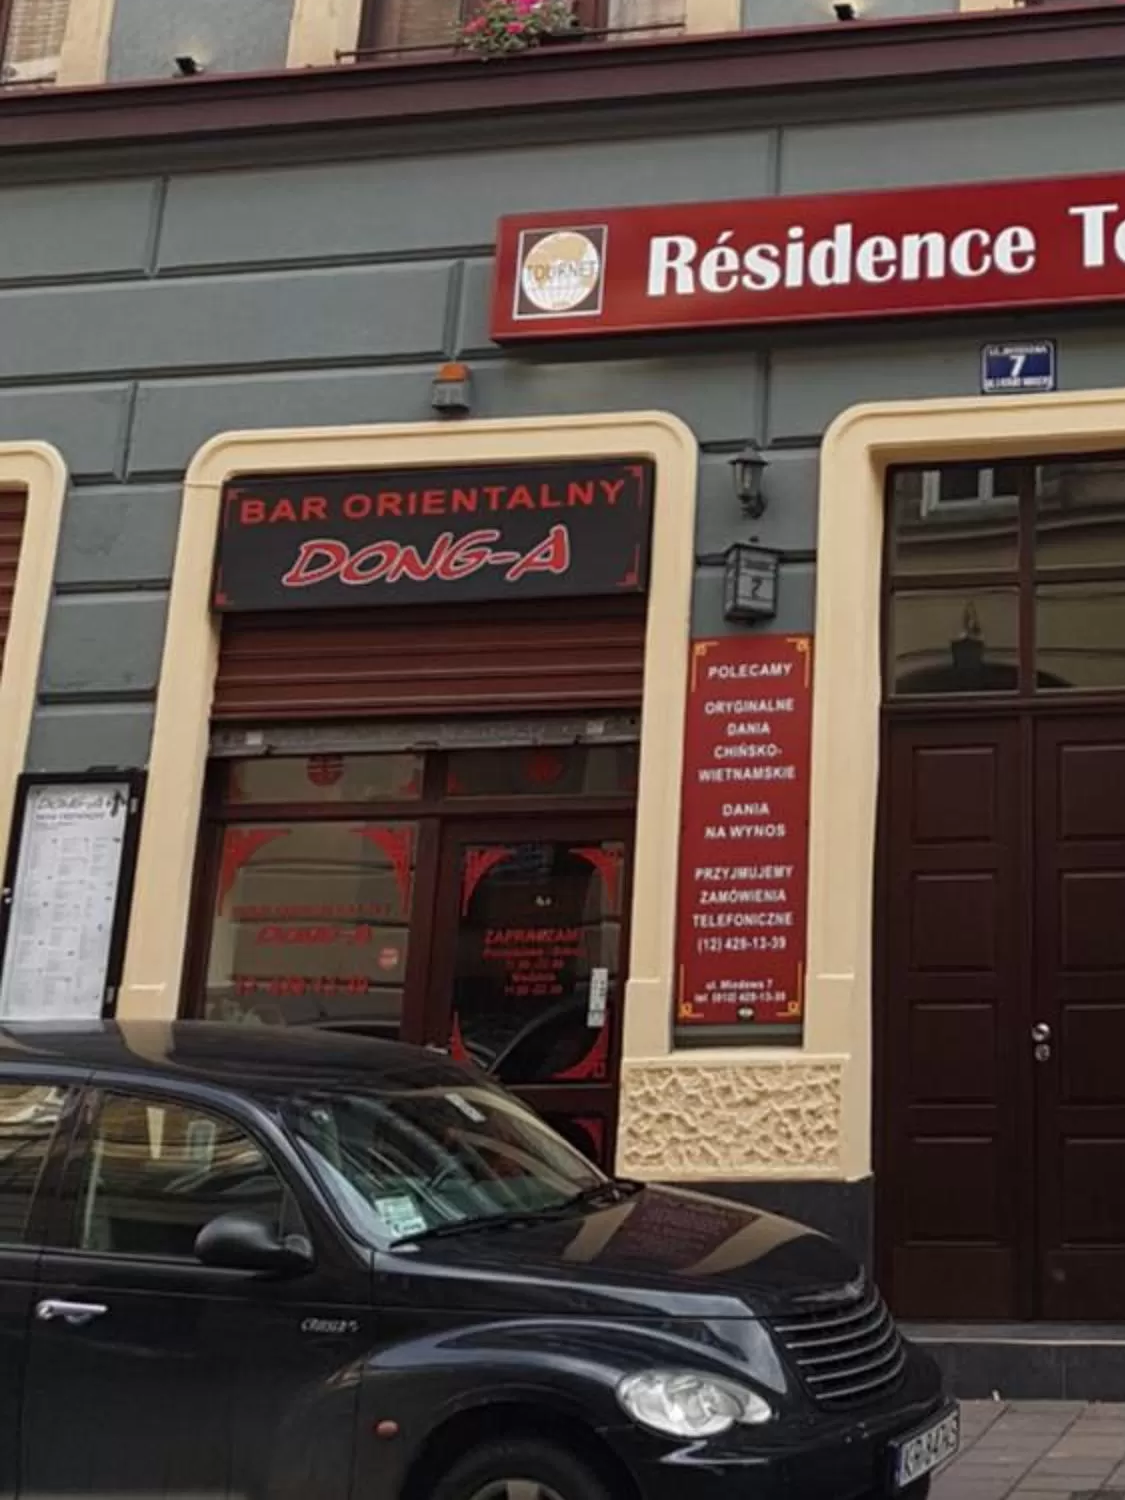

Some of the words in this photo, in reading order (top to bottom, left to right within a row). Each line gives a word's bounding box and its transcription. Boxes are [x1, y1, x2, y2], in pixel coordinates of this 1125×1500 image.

[647, 221, 1036, 297] Résidence
[1009, 354, 1026, 377] 7
[240, 497, 327, 524] BAR
[343, 480, 625, 518] ORIENTALNY
[282, 523, 571, 587] DONG-A
[707, 663, 793, 679] POLECAMY
[704, 698, 795, 715] ORYGINALNE
[727, 722, 771, 737] DANIA
[698, 766, 797, 782] WIETNAMSKIE
[722, 803, 770, 817] DANIA
[705, 825, 727, 840] NA
[729, 823, 786, 838] WYNOS
[693, 864, 795, 881] PRZYJMUJEMY
[700, 887, 788, 904] ZAMÓWIENIA
[692, 911, 794, 928] TELEFONICZNE
